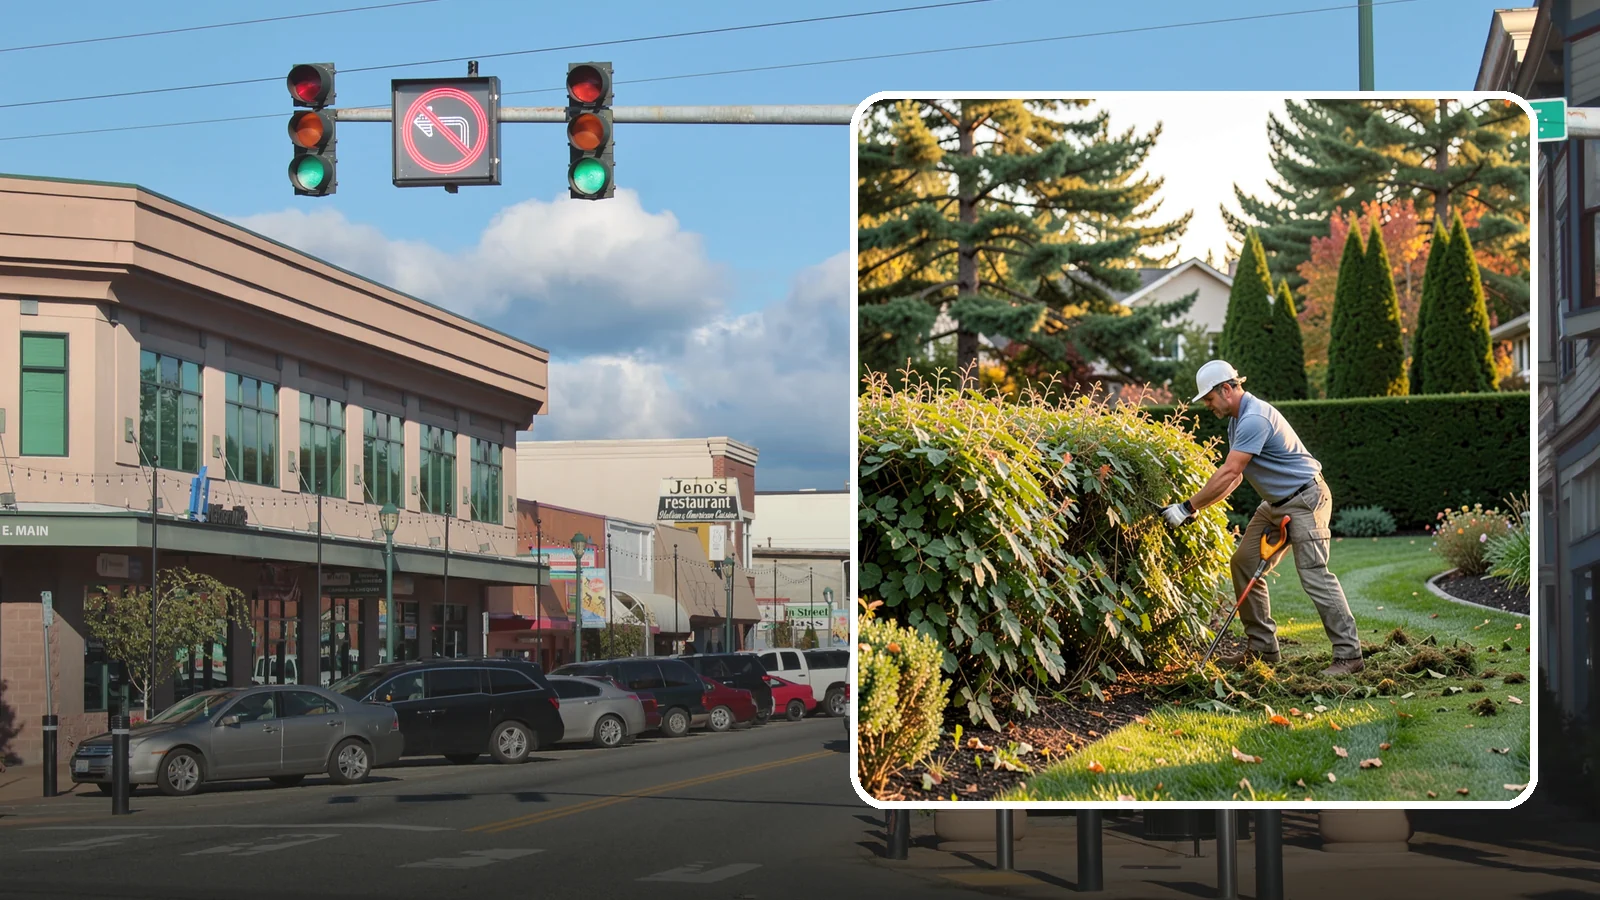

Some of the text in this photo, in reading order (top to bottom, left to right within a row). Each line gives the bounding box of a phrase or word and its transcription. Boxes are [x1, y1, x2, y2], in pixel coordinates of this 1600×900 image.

[669, 480, 728, 495] Jeno's
[665, 496, 731, 509] restaurant
[658, 509, 681, 519] Italian
[685, 509, 715, 519] American
[715, 509, 737, 519] Cuisine
[2, 525, 49, 536] E. MAIN
[797, 607, 828, 616] Street
[790, 619, 823, 627] lass
